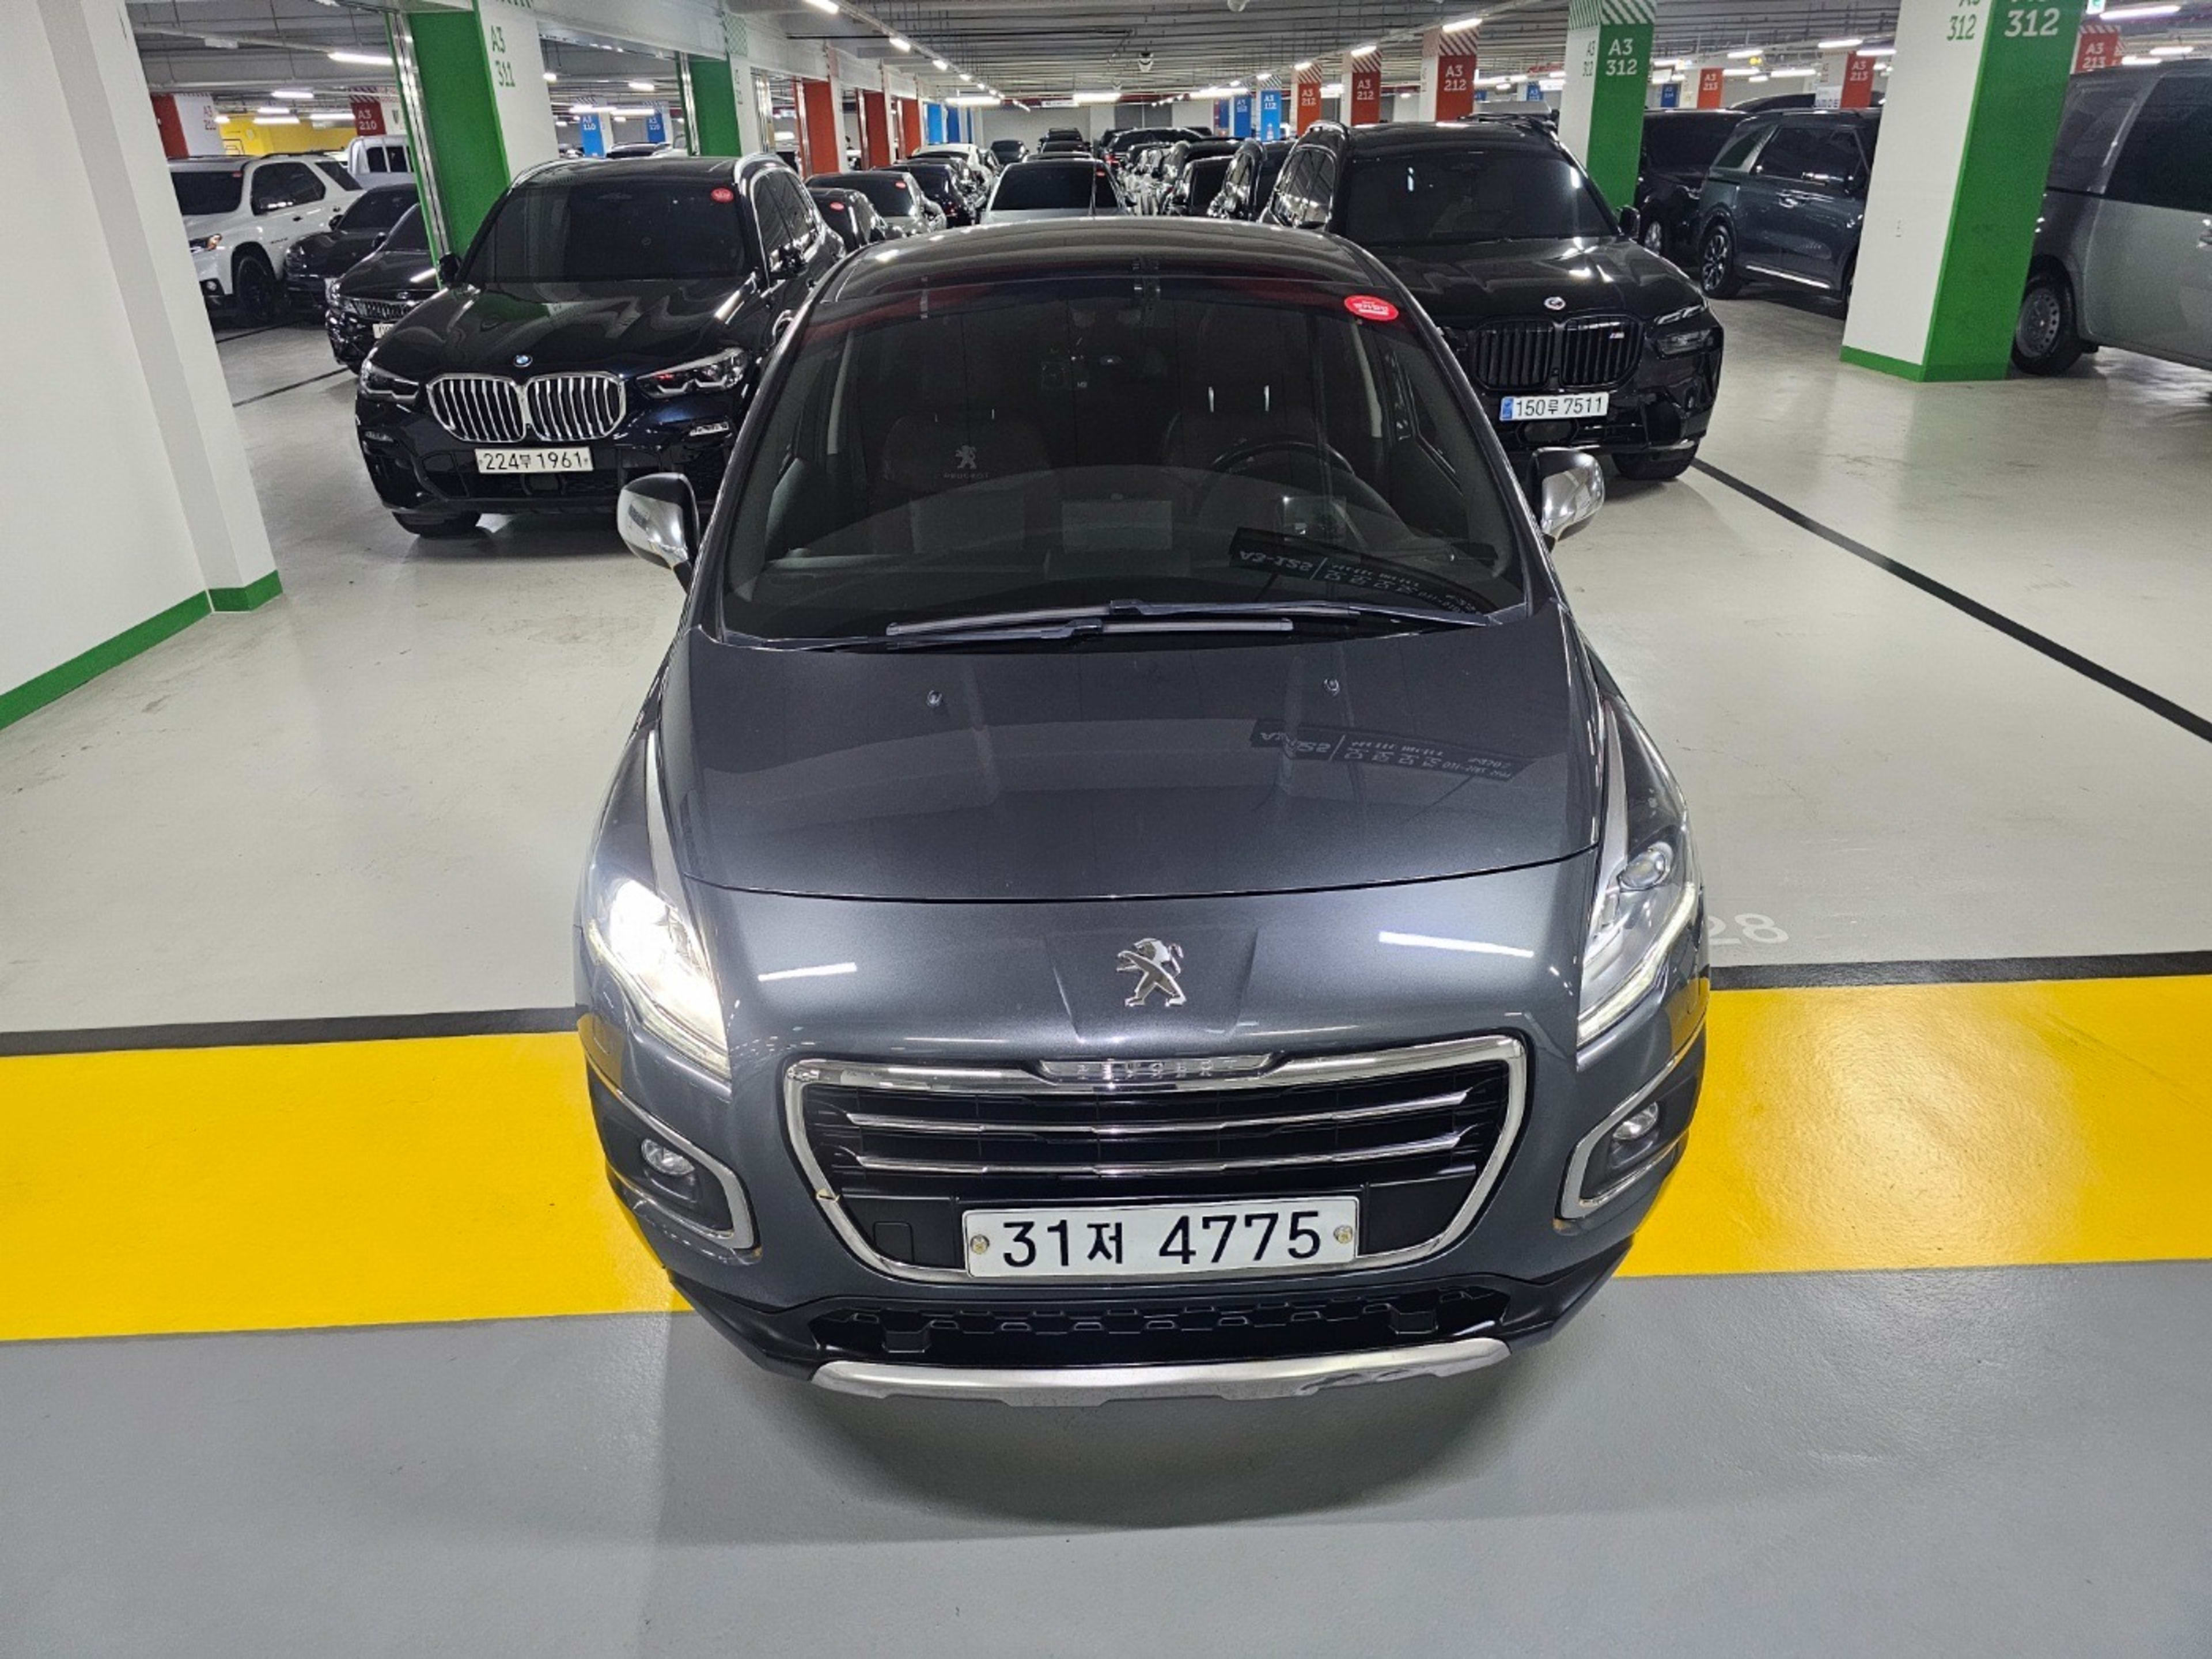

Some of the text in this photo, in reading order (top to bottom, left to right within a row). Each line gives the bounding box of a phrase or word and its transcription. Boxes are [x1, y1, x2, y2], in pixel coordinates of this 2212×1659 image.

[1946, 14, 1977, 41] 312
[2004, 7, 2061, 37] 312
[491, 25, 506, 53] A3
[1608, 38, 1634, 56] A3
[2085, 42, 2104, 55] A3
[1605, 58, 1638, 76] 312
[1850, 60, 1866, 70] A3
[2082, 56, 2106, 69] 213
[1445, 65, 1464, 77] A3
[1705, 73, 1717, 82] A3
[1850, 71, 1868, 81] 213
[1357, 79, 1372, 89] A3
[1444, 79, 1467, 92] 212
[1301, 88, 1314, 97] A3
[1356, 91, 1374, 101] 212
[358, 109, 372, 119] A3
[359, 120, 377, 131] 210
[1563, 396, 1602, 415] 7511
[536, 451, 582, 469] 1961
[1002, 1210, 1323, 1268] 31저 4775
